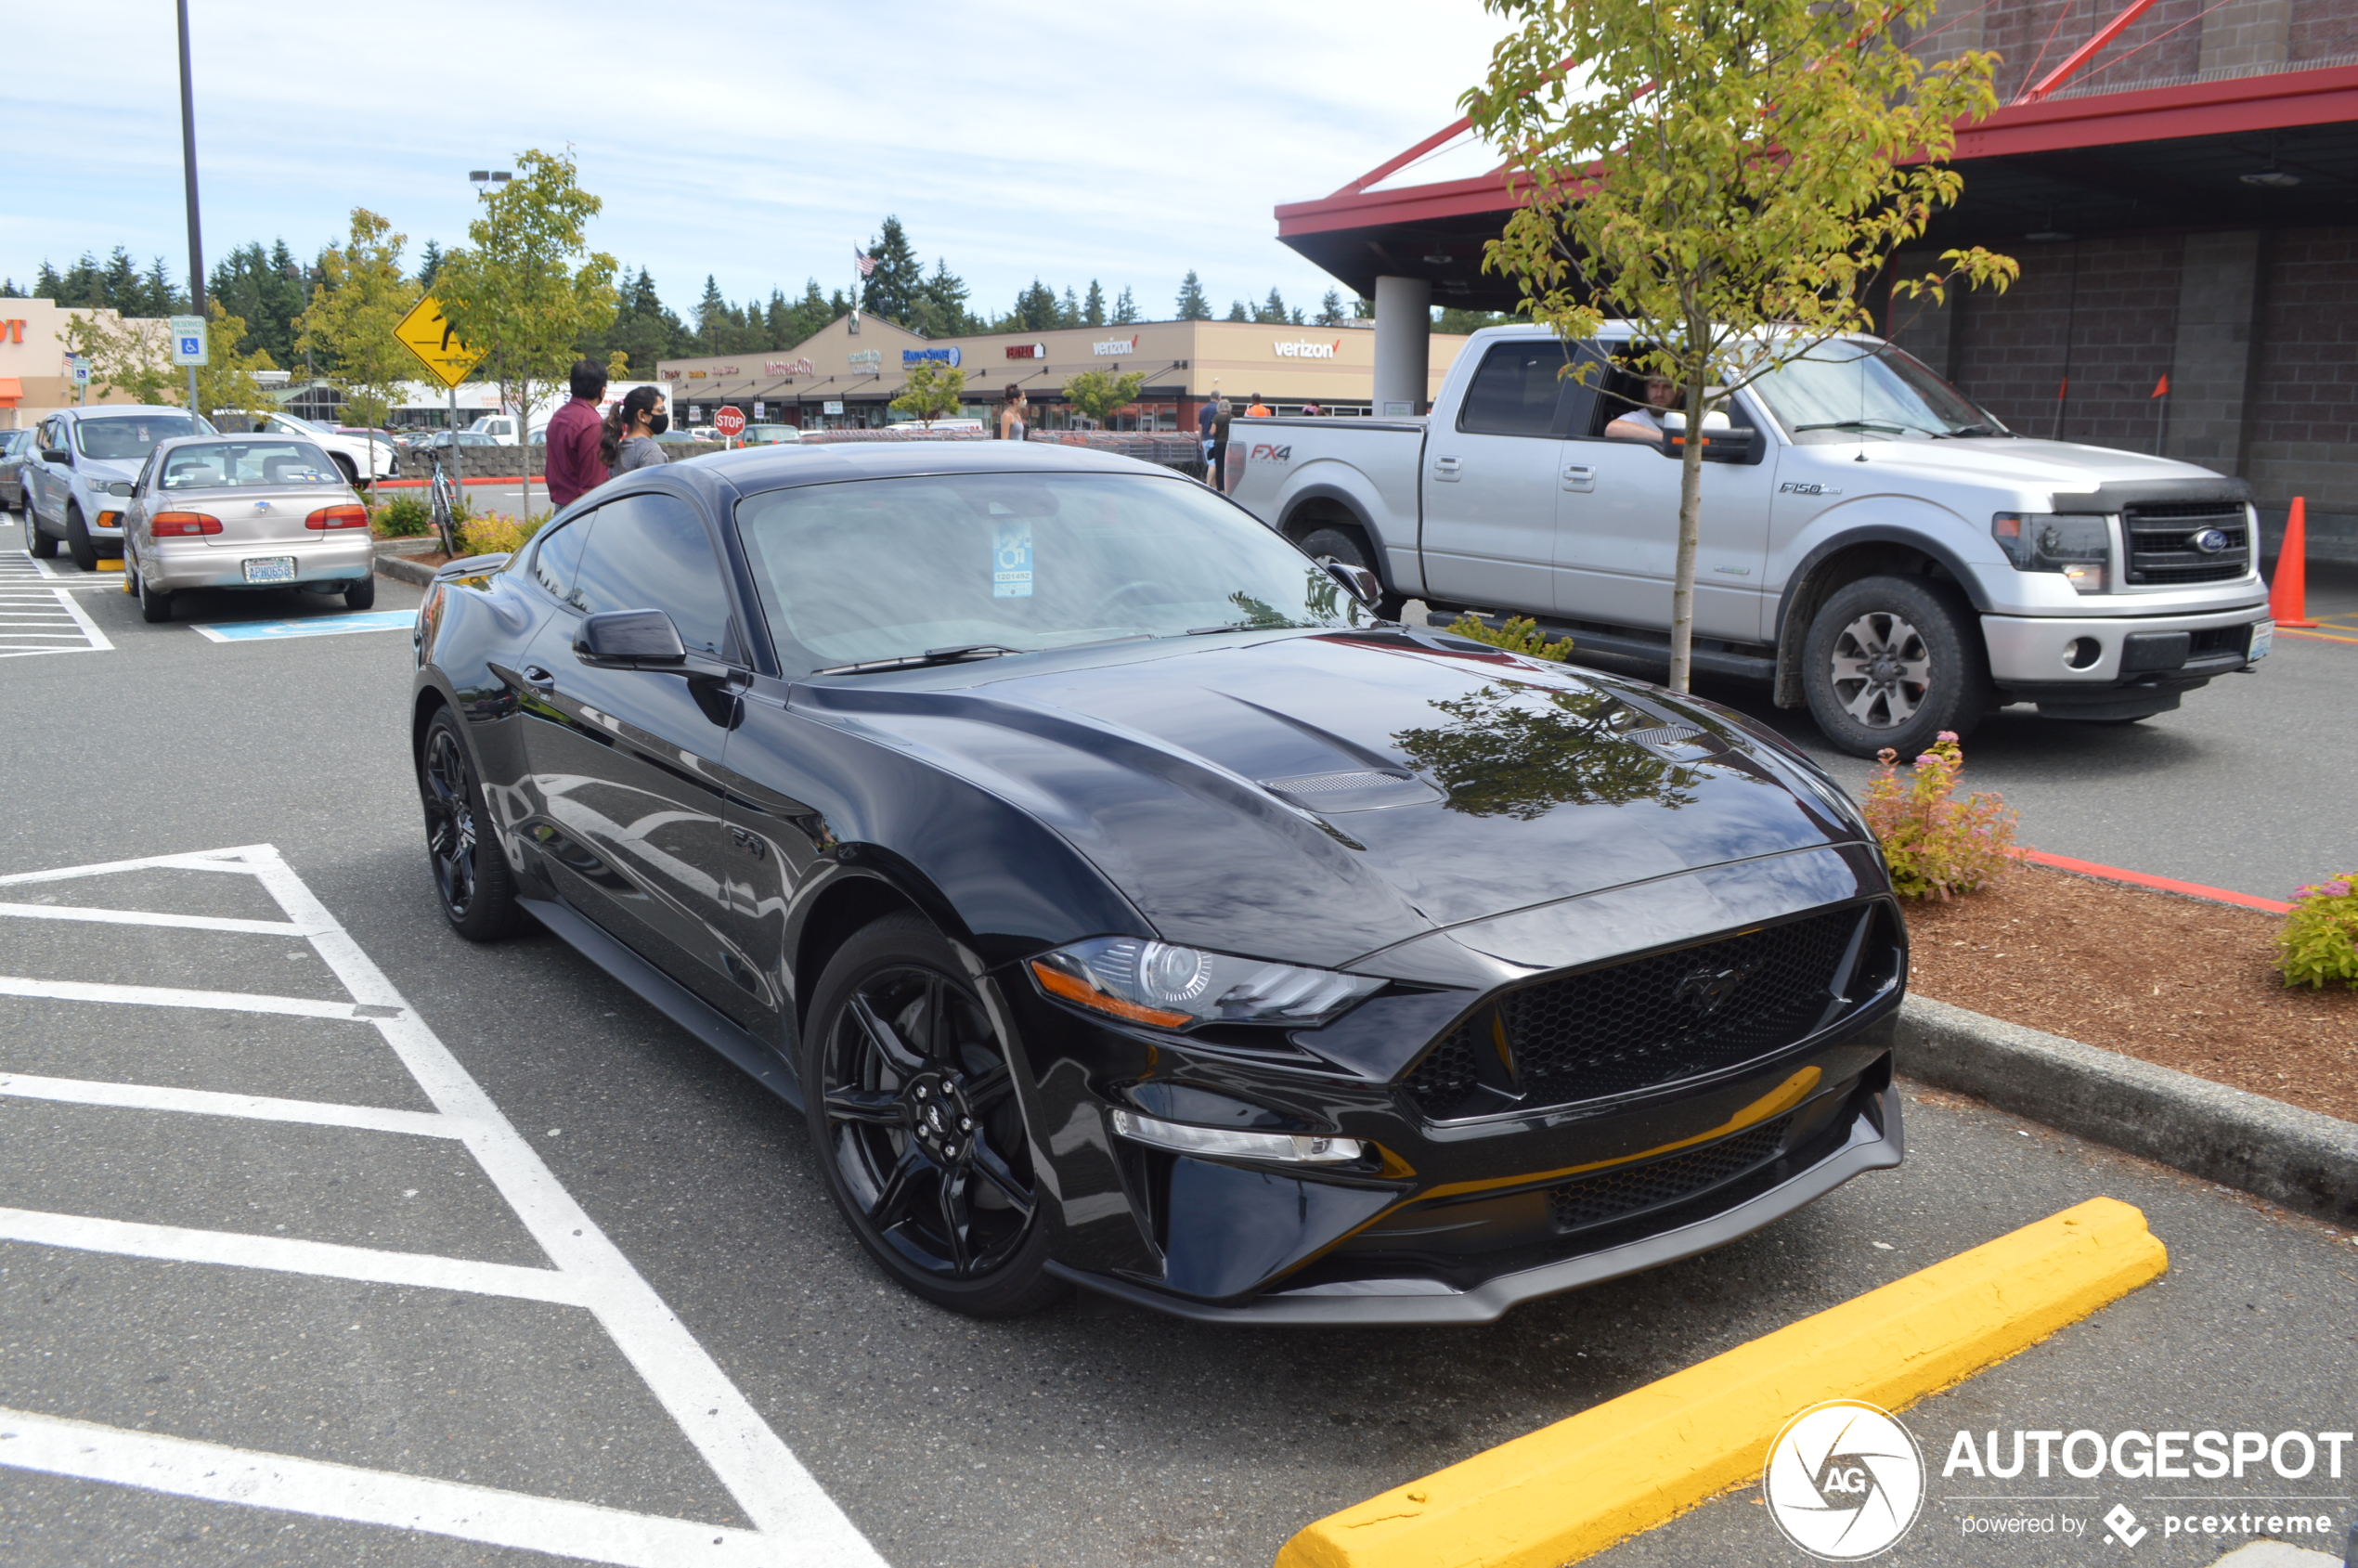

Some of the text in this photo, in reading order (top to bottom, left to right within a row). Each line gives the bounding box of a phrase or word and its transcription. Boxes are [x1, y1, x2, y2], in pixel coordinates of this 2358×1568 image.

[1004, 345, 1034, 358] TERIYAKI
[1093, 337, 1133, 356] verizon
[1274, 339, 1333, 358] verizon
[765, 357, 815, 378] Mattress City
[716, 415, 743, 428] STOP
[1250, 444, 1292, 461] FX4
[2206, 533, 2224, 547] Ford
